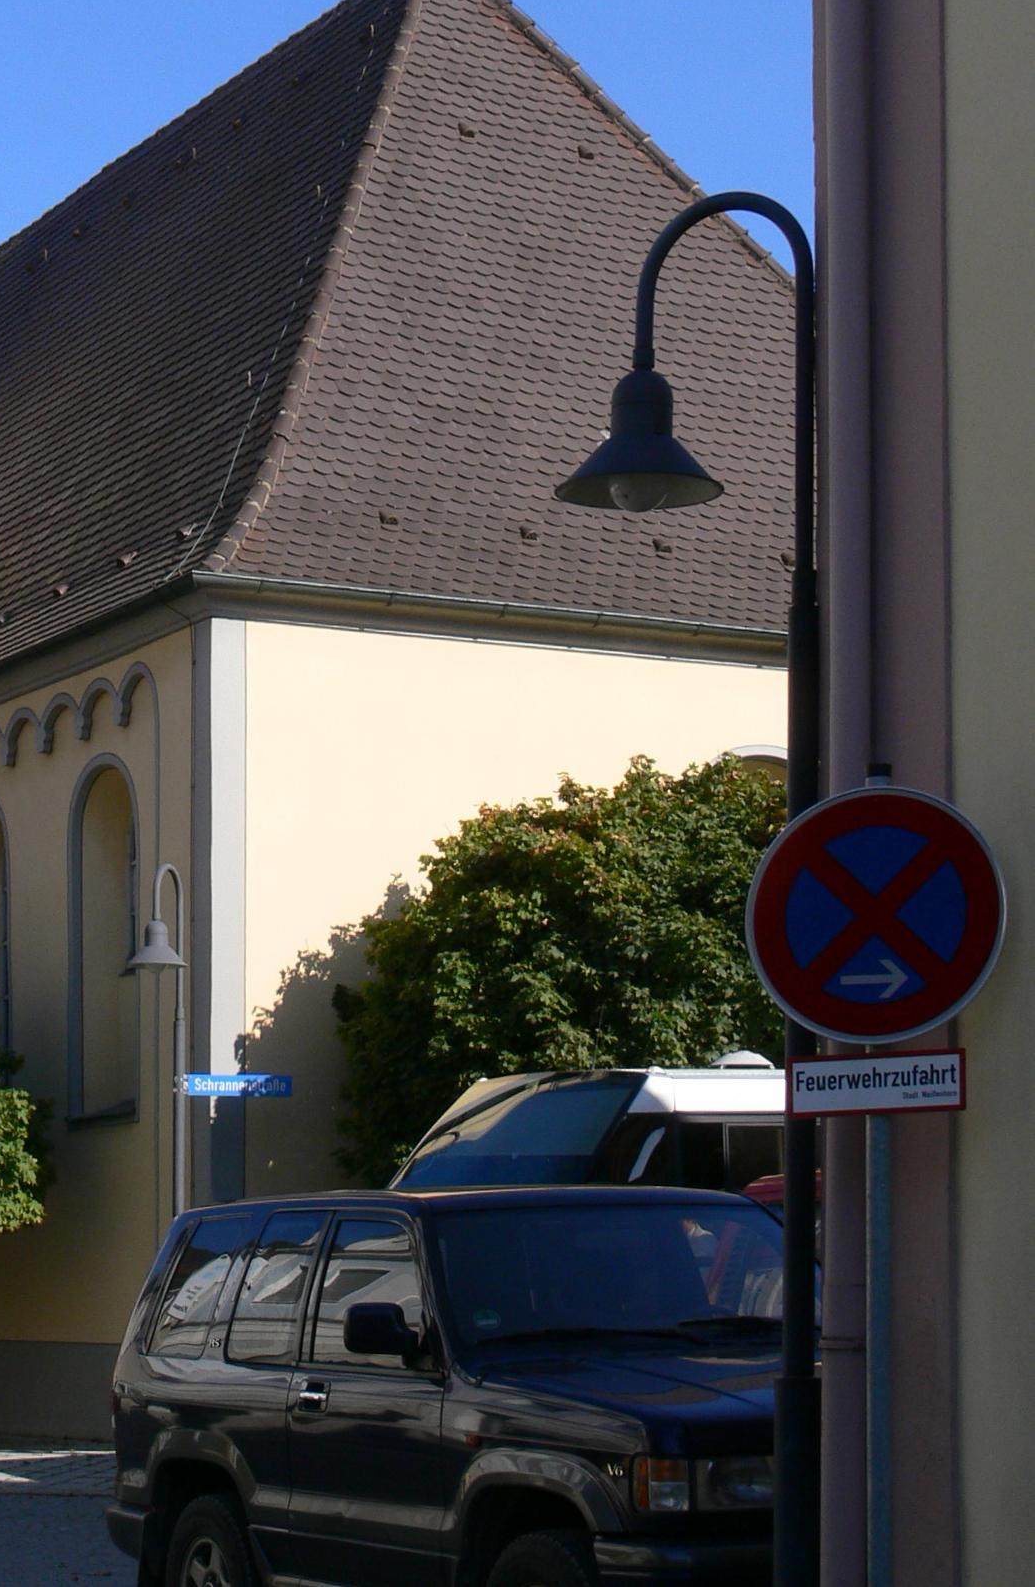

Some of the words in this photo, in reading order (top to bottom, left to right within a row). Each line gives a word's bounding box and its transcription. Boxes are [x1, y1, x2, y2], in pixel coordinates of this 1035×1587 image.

[194, 1077, 286, 1092] Schrannenstraße
[796, 1064, 956, 1092] Feuerwehrzufahrt
[606, 1463, 623, 1477] V6
